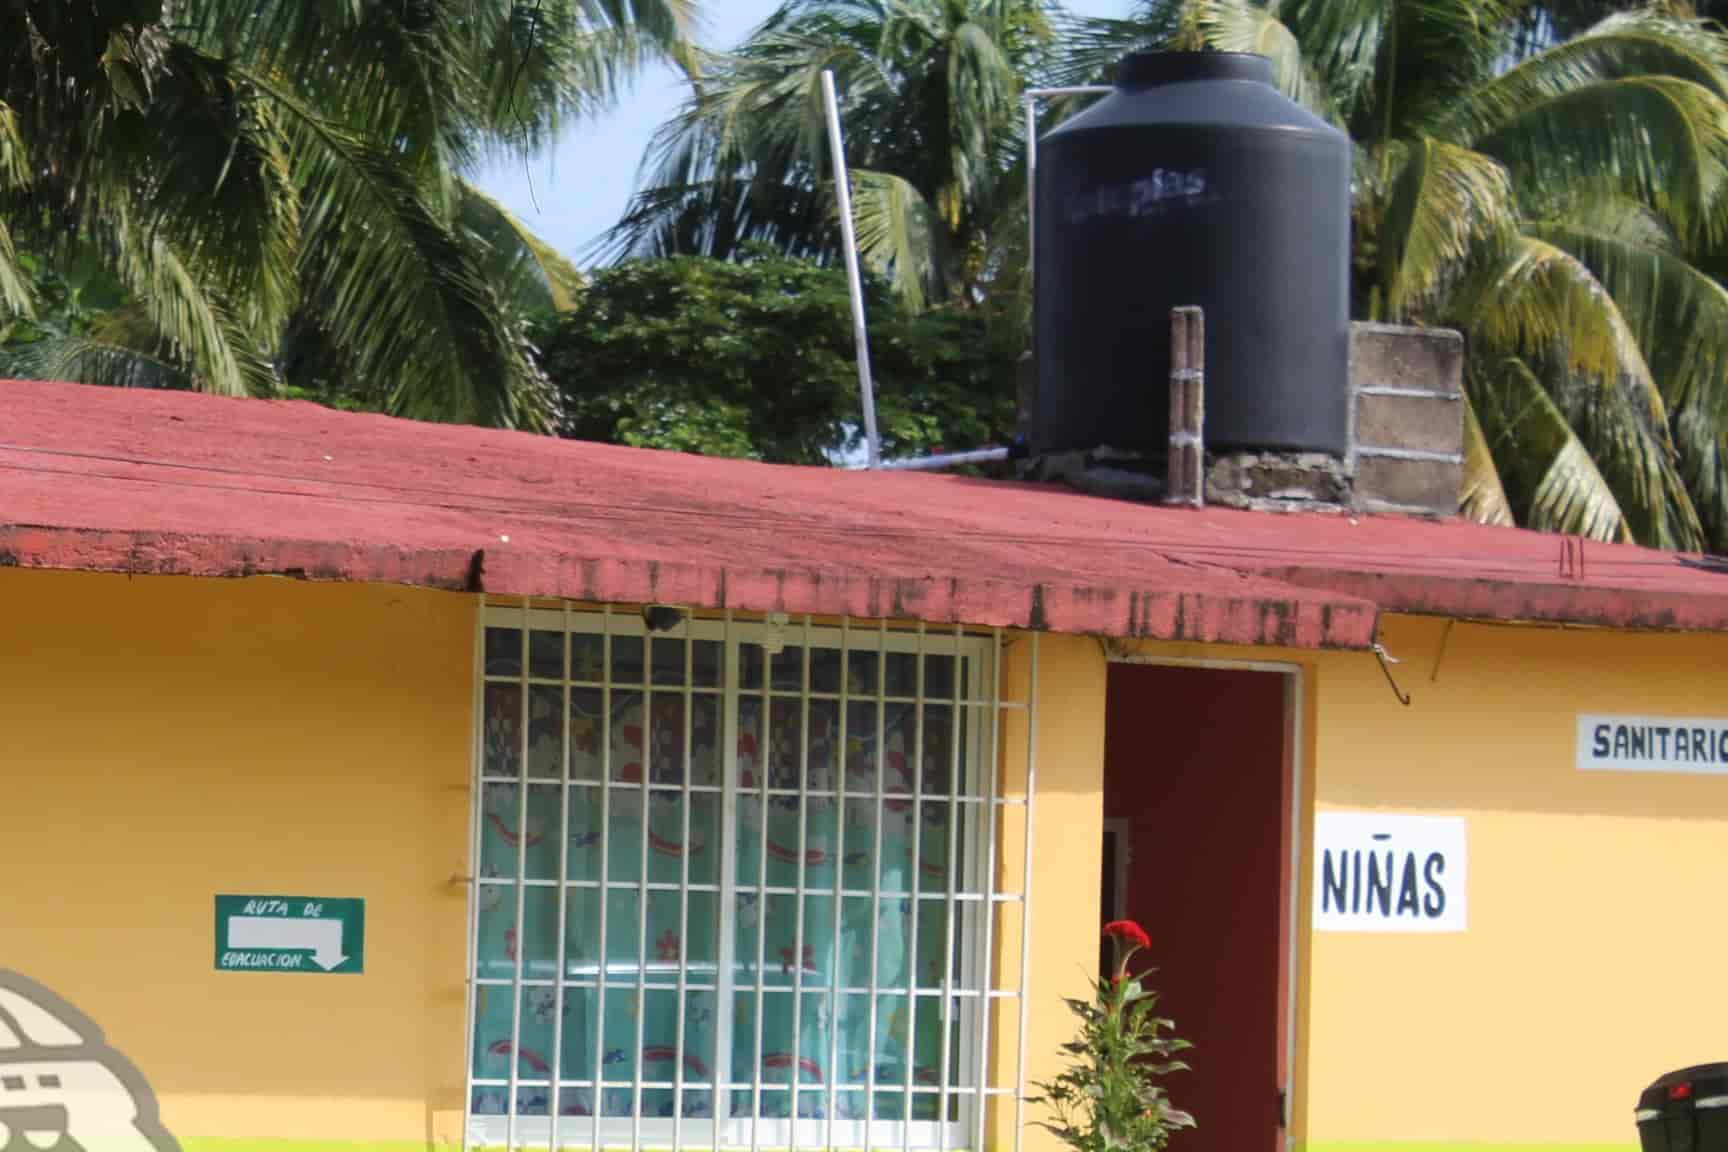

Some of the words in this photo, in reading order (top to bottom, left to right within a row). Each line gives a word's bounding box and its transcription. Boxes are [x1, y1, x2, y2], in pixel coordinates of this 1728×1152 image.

[1321, 833, 1447, 919] NIÑAS
[243, 899, 289, 916] RUTA
[303, 902, 323, 918] DE
[221, 951, 304, 968] EVACUACION
